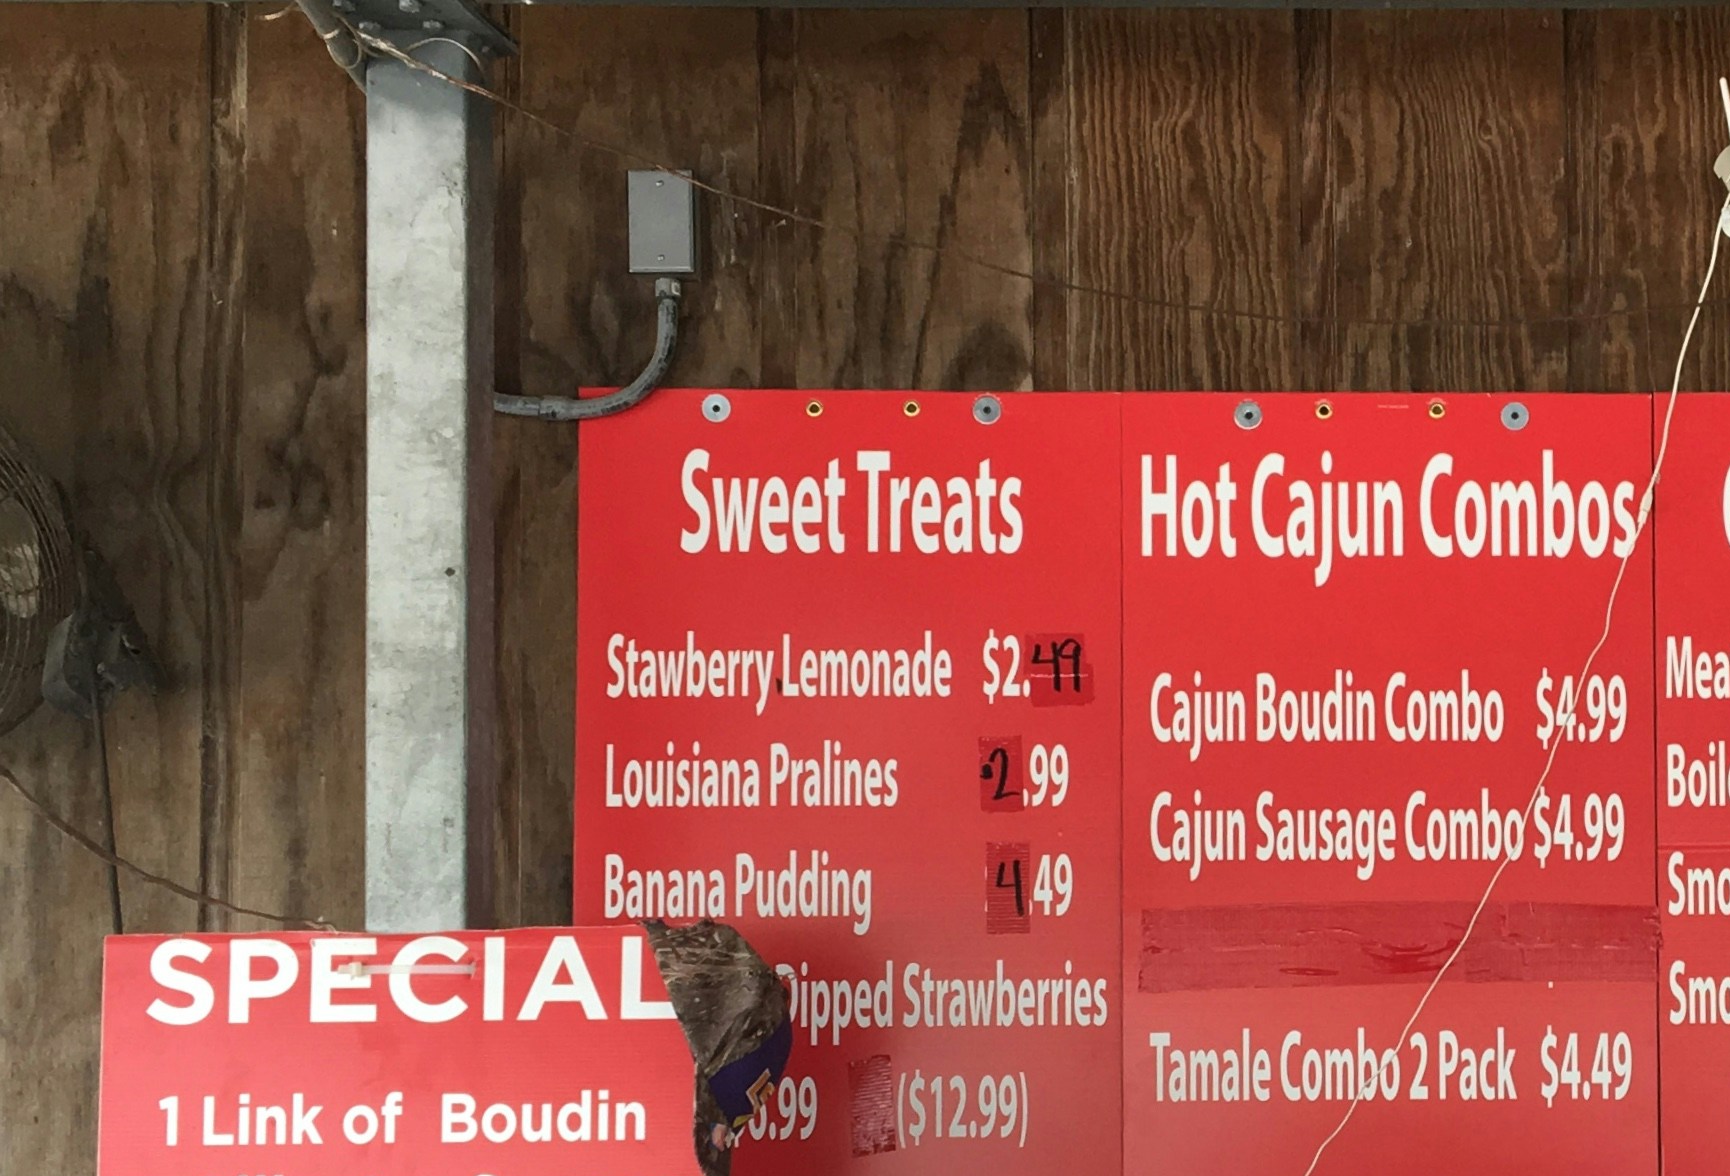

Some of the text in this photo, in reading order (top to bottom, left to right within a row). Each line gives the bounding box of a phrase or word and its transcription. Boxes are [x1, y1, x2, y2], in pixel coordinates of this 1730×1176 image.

[681, 449, 1023, 553] Sweet Treats
[1142, 446, 1636, 586] Hot Cajun Combos
[607, 628, 1081, 715] Stawberry Lemonade $2.49
[1151, 667, 1629, 761] Cajun Boudin Combo $4.99
[606, 742, 759, 807] Louisiana
[770, 740, 898, 806] Pralines
[1151, 786, 1627, 880] Cajun Sausage Combo $4.99
[605, 854, 725, 918] Banana
[736, 850, 871, 935] Pudding
[146, 934, 682, 1024] SPECIAL
[904, 960, 1107, 1027] Strawberries
[898, 1070, 1027, 1148] ($12.99)
[1150, 1025, 1632, 1107] Tamale Combo 2 Pack $4.49
[159, 1090, 645, 1146] 1 Link of Boudin
